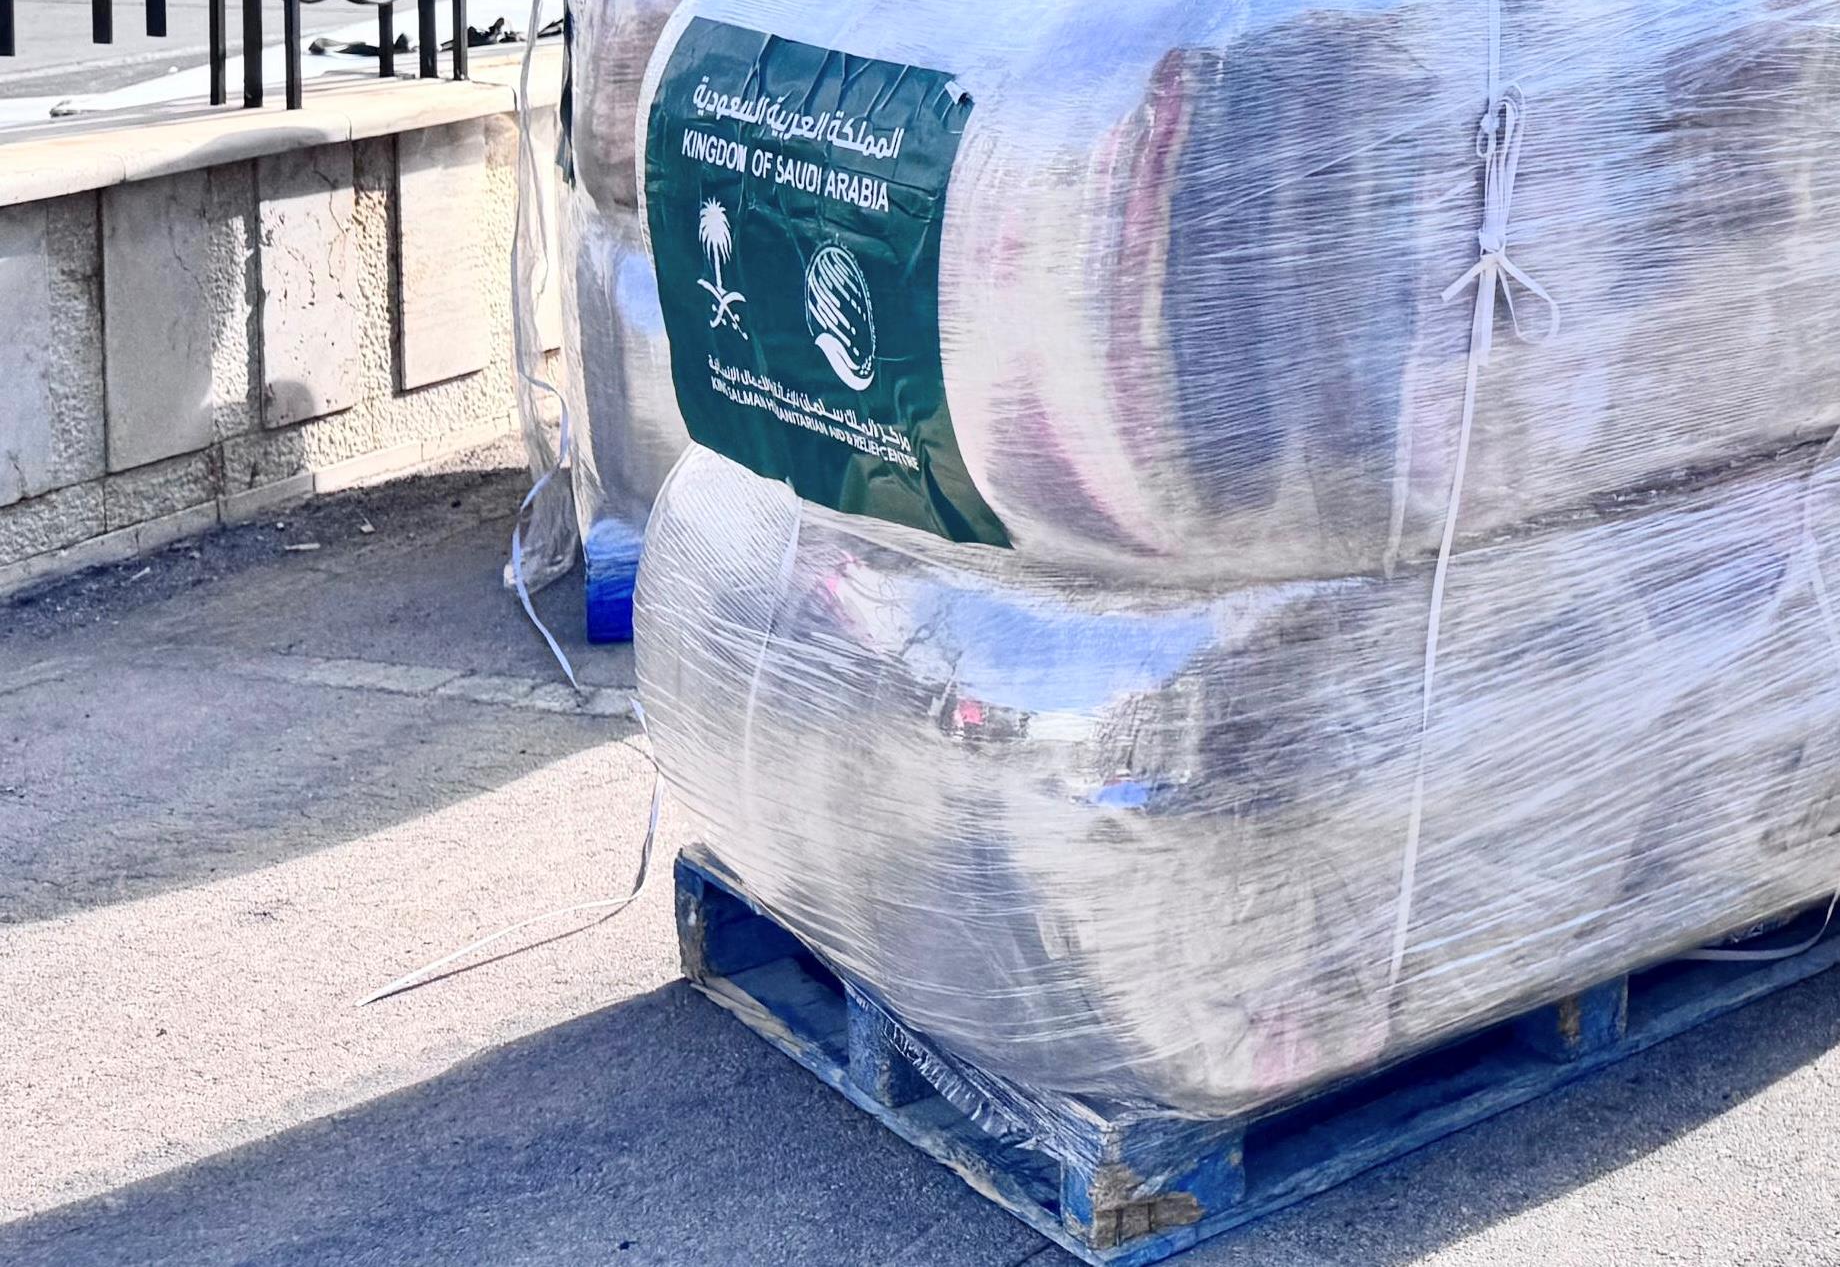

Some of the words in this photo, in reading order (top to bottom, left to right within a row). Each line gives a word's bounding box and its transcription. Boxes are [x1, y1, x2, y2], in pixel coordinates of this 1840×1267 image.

[693, 75, 770, 125] السعودية
[766, 96, 830, 141] العربية
[827, 110, 905, 159] المملكة
[682, 128, 748, 173] KINGDOM
[751, 149, 774, 179] OF
[775, 154, 823, 195] SAUDI
[824, 169, 889, 212] ARABIA
